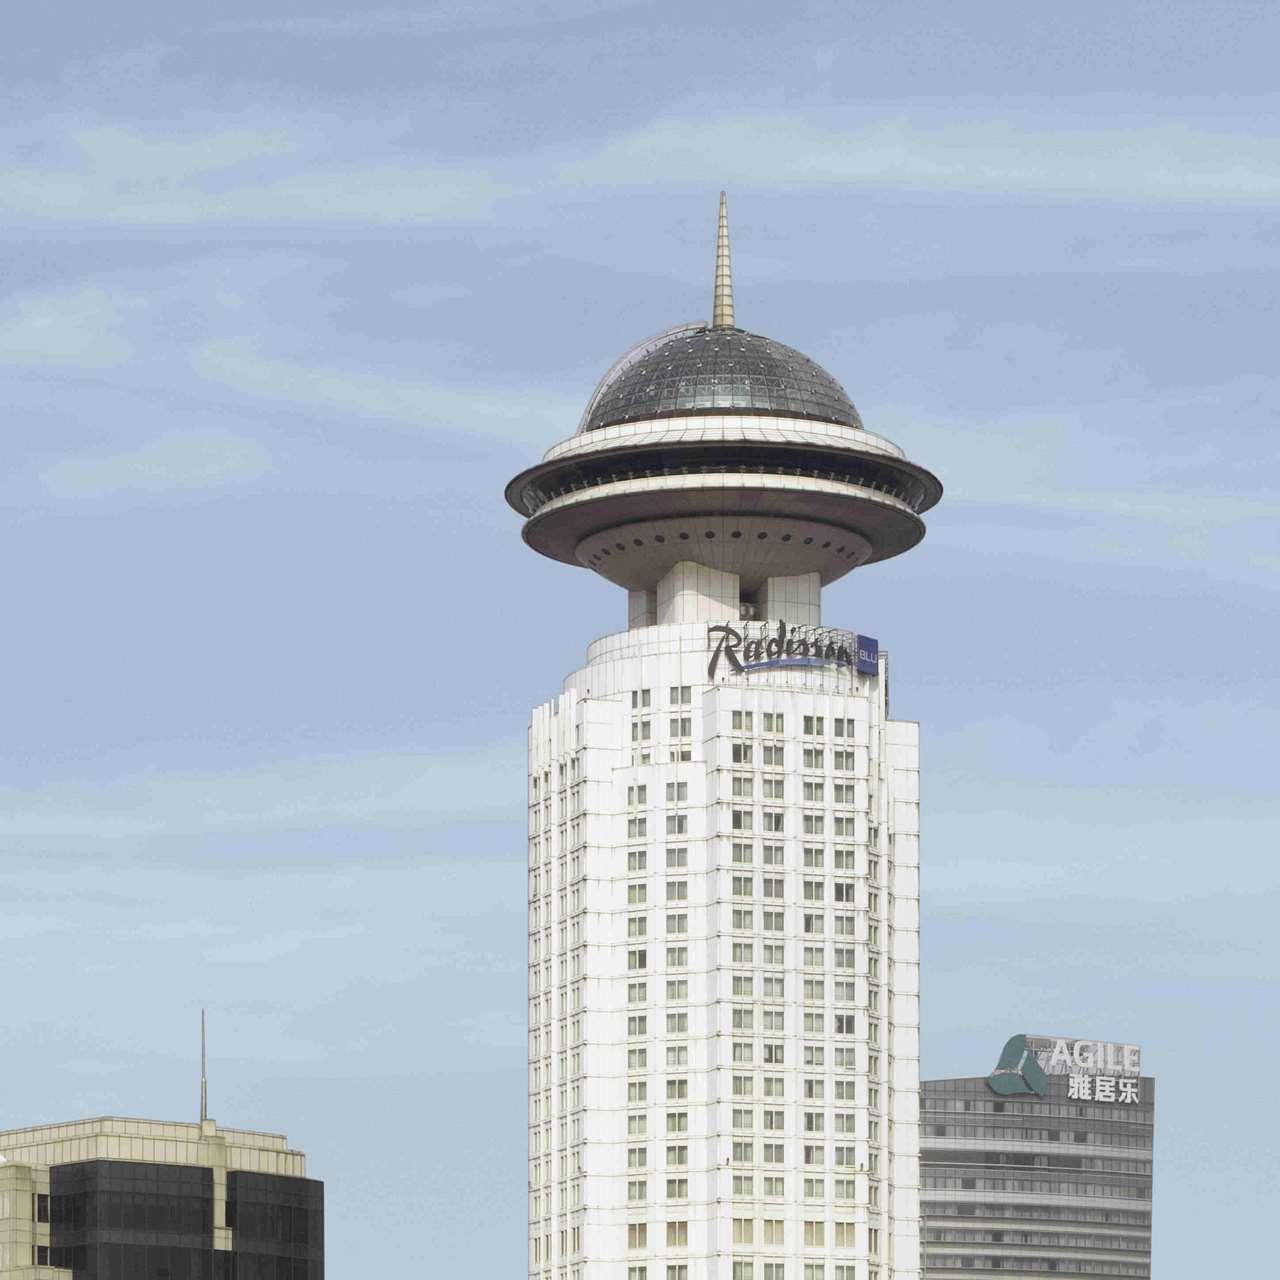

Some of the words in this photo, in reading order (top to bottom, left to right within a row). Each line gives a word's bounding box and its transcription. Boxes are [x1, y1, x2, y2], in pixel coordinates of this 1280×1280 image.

[708, 619, 853, 681] Radisson
[860, 649, 878, 664] BLU
[1051, 1039, 1140, 1072] AGILE
[1068, 1073, 1140, 1104] 雅居乐
